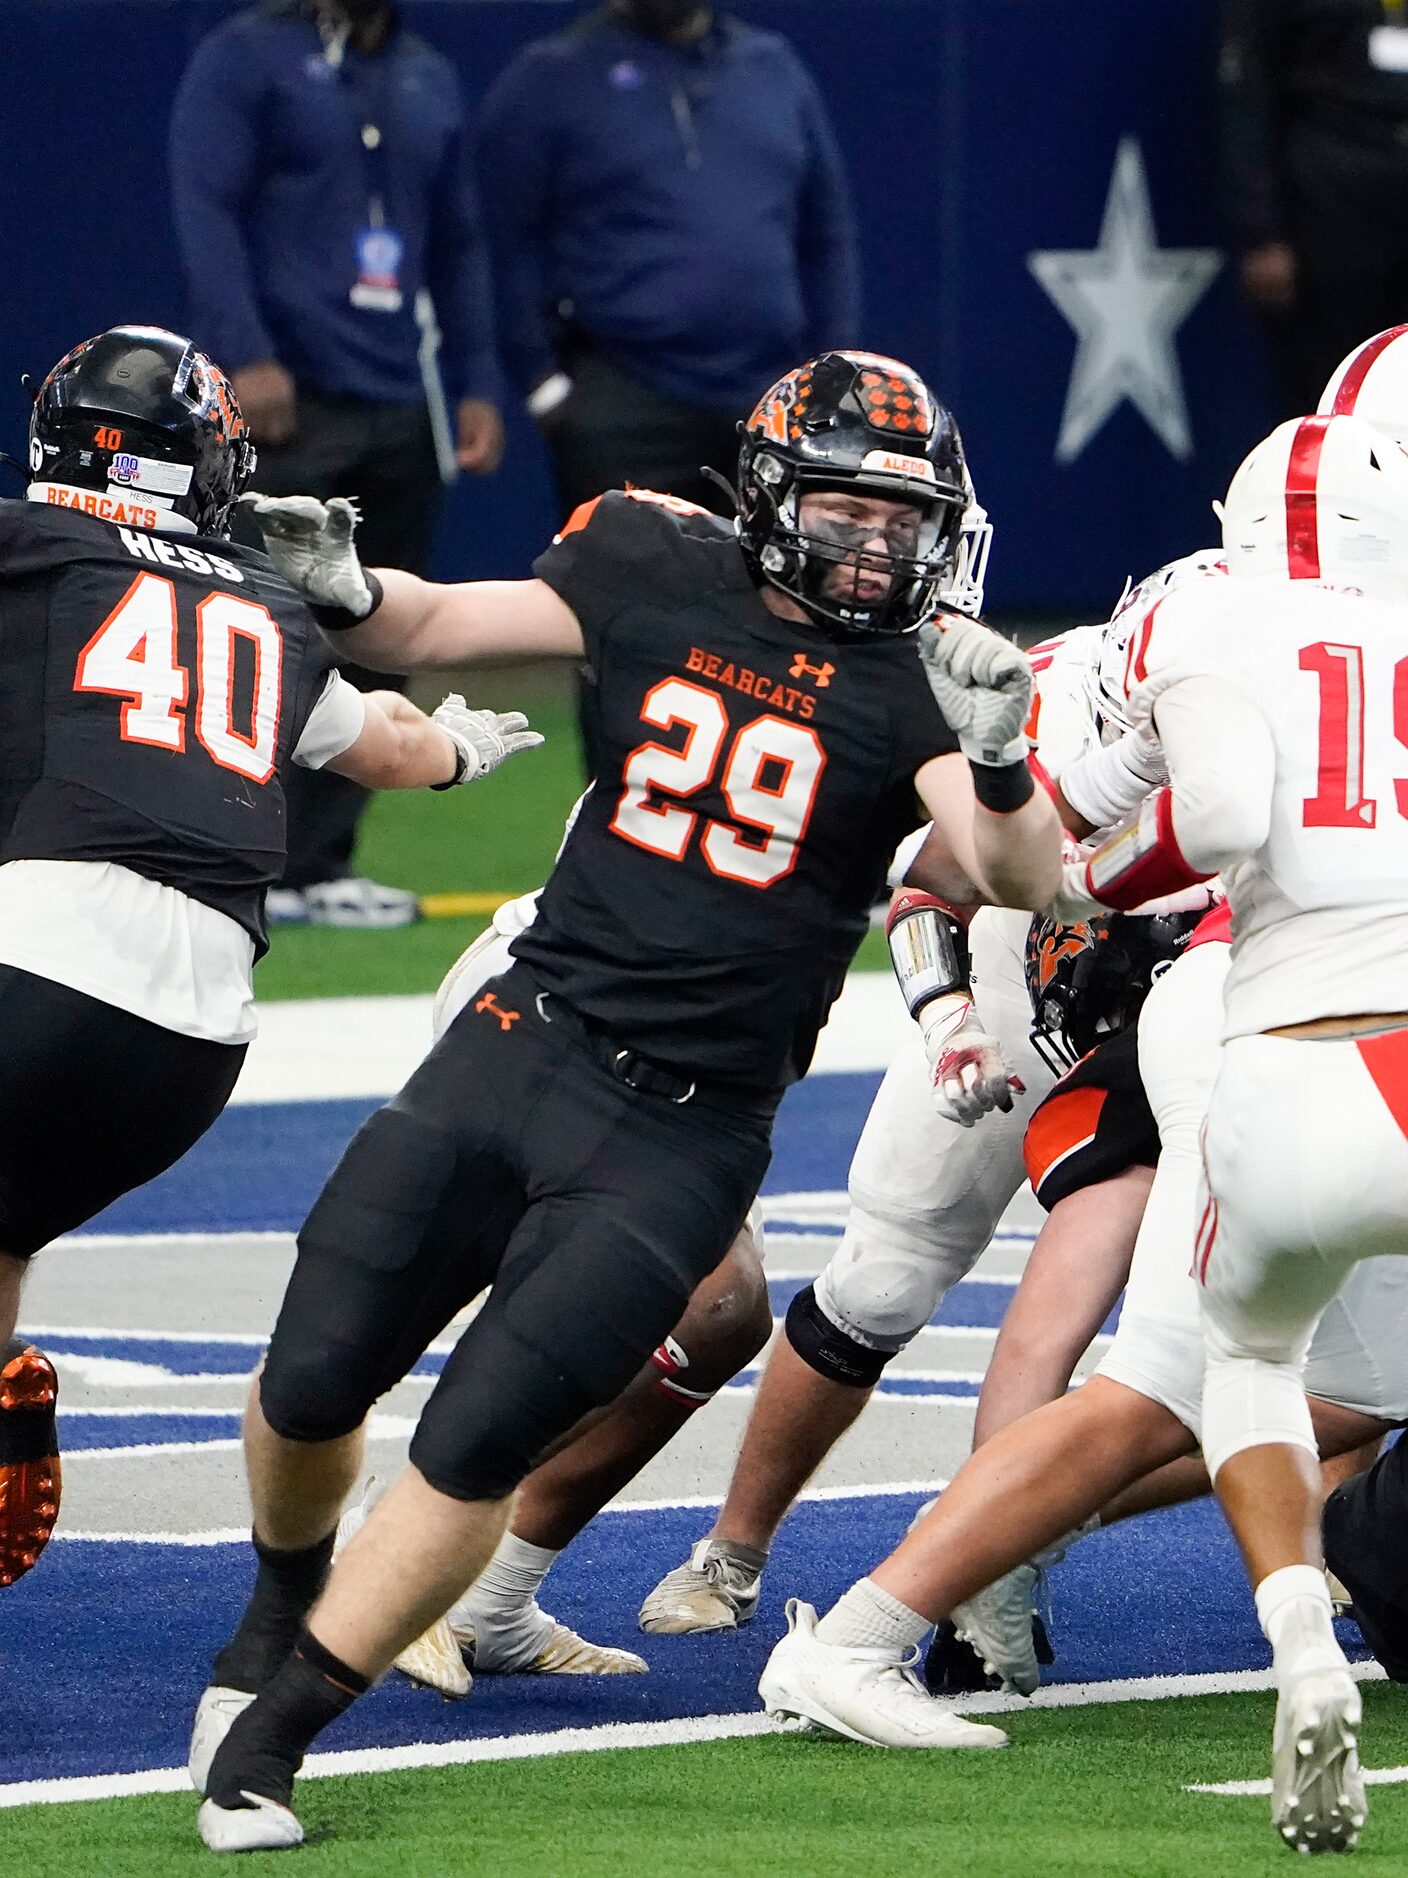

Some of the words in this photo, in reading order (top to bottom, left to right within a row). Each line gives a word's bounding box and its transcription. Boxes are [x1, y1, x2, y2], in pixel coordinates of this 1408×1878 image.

[94, 427, 122, 451] 40
[115, 455, 139, 471] 100
[883, 457, 925, 475] ALEDO
[47, 486, 157, 530] BEARCATS
[130, 491, 154, 504] HESS
[117, 525, 245, 583] HESS
[72, 569, 284, 786] 40
[685, 646, 818, 720] BEARCATS
[608, 674, 828, 890] 29
